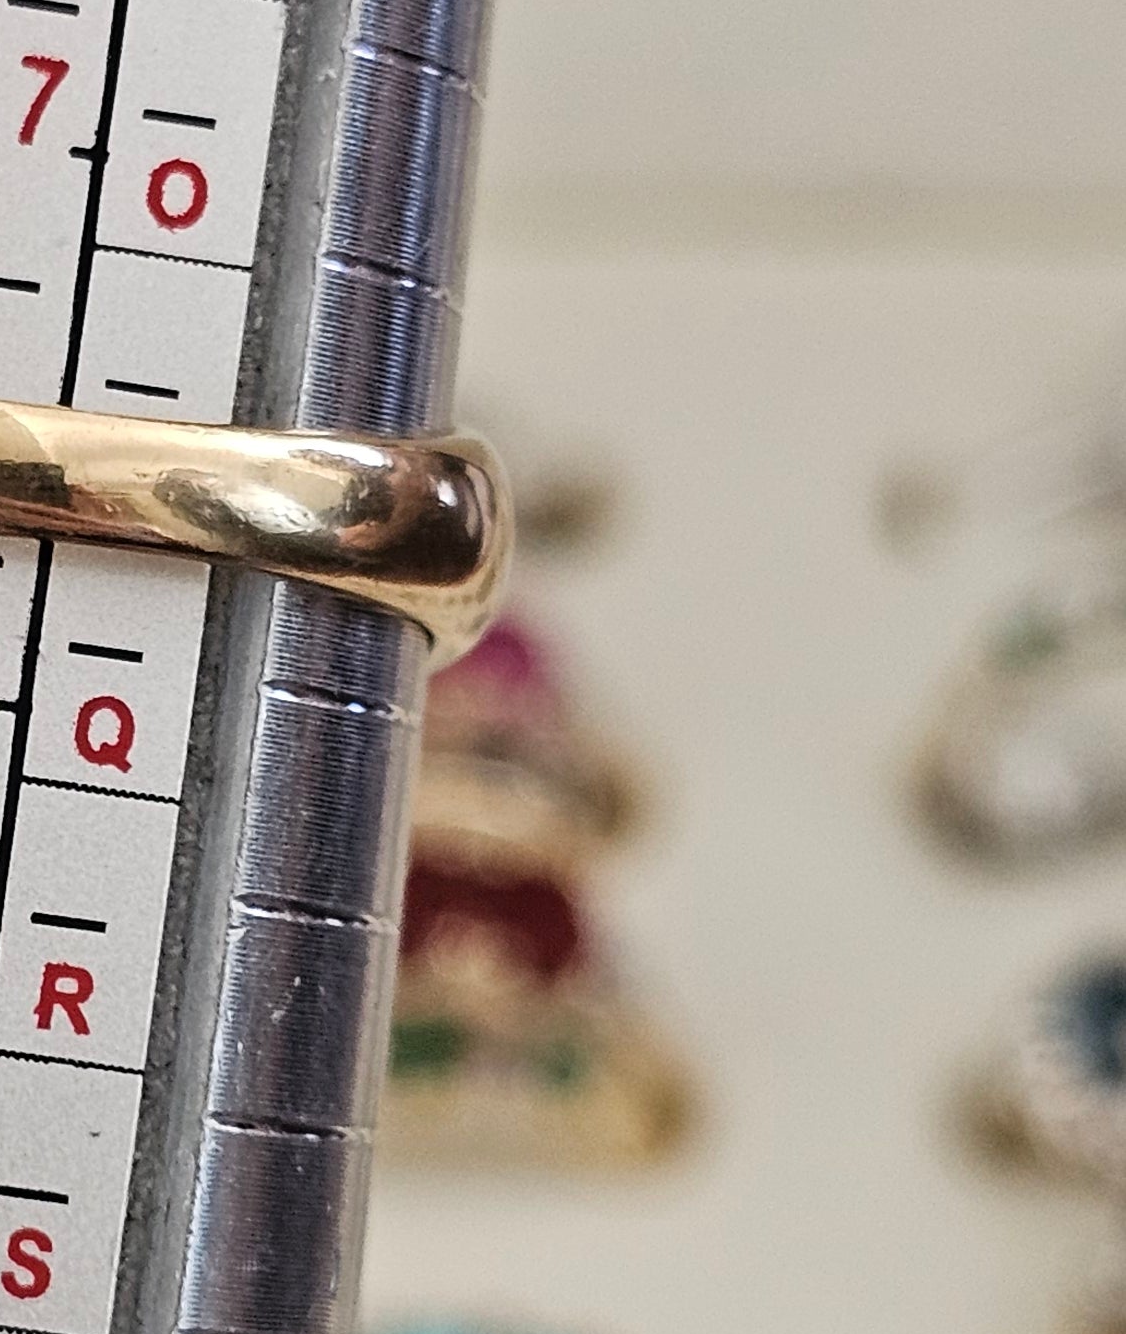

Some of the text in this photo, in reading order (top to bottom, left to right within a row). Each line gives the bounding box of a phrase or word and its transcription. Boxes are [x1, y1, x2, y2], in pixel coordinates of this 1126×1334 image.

[19, 54, 69, 144] 7
[146, 158, 208, 229] O
[75, 696, 134, 771] Q
[34, 962, 94, 1035] R
[1, 1228, 52, 1298] S
